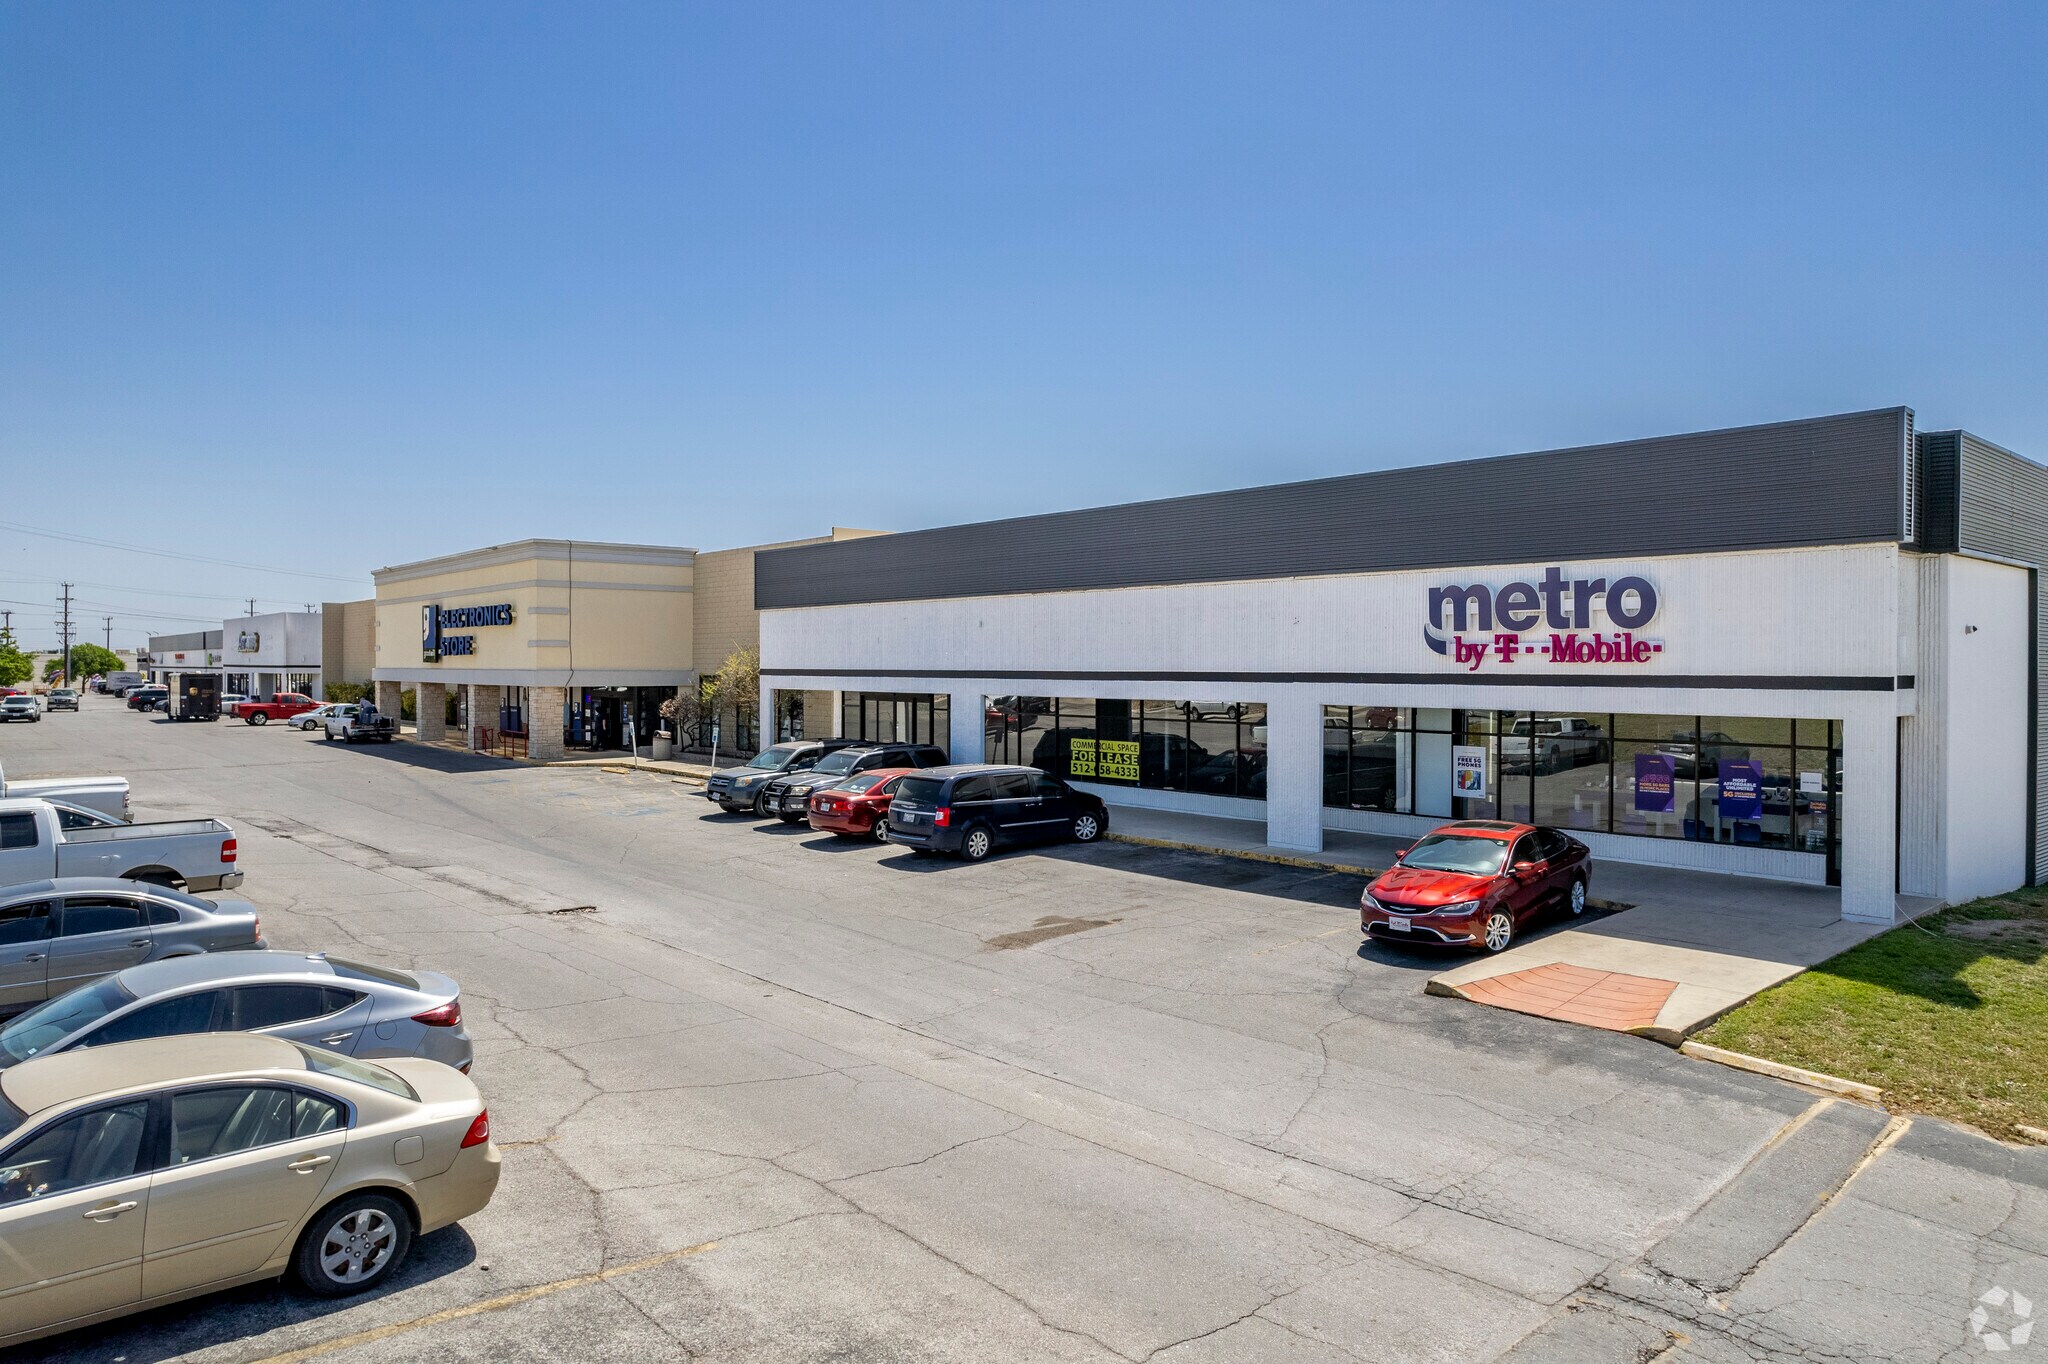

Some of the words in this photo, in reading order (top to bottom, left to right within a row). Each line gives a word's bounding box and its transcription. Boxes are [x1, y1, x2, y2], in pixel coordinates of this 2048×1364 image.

[1425, 567, 1658, 633] metro
[440, 604, 512, 628] ELECTRONICS
[440, 636, 473, 656] STORE
[1453, 636, 1488, 671] by
[1072, 750, 1096, 762] FOR
[1100, 752, 1138, 765] LEASE
[1118, 744, 1138, 752] SPACE
[1073, 764, 1138, 777] 512-58-4333
